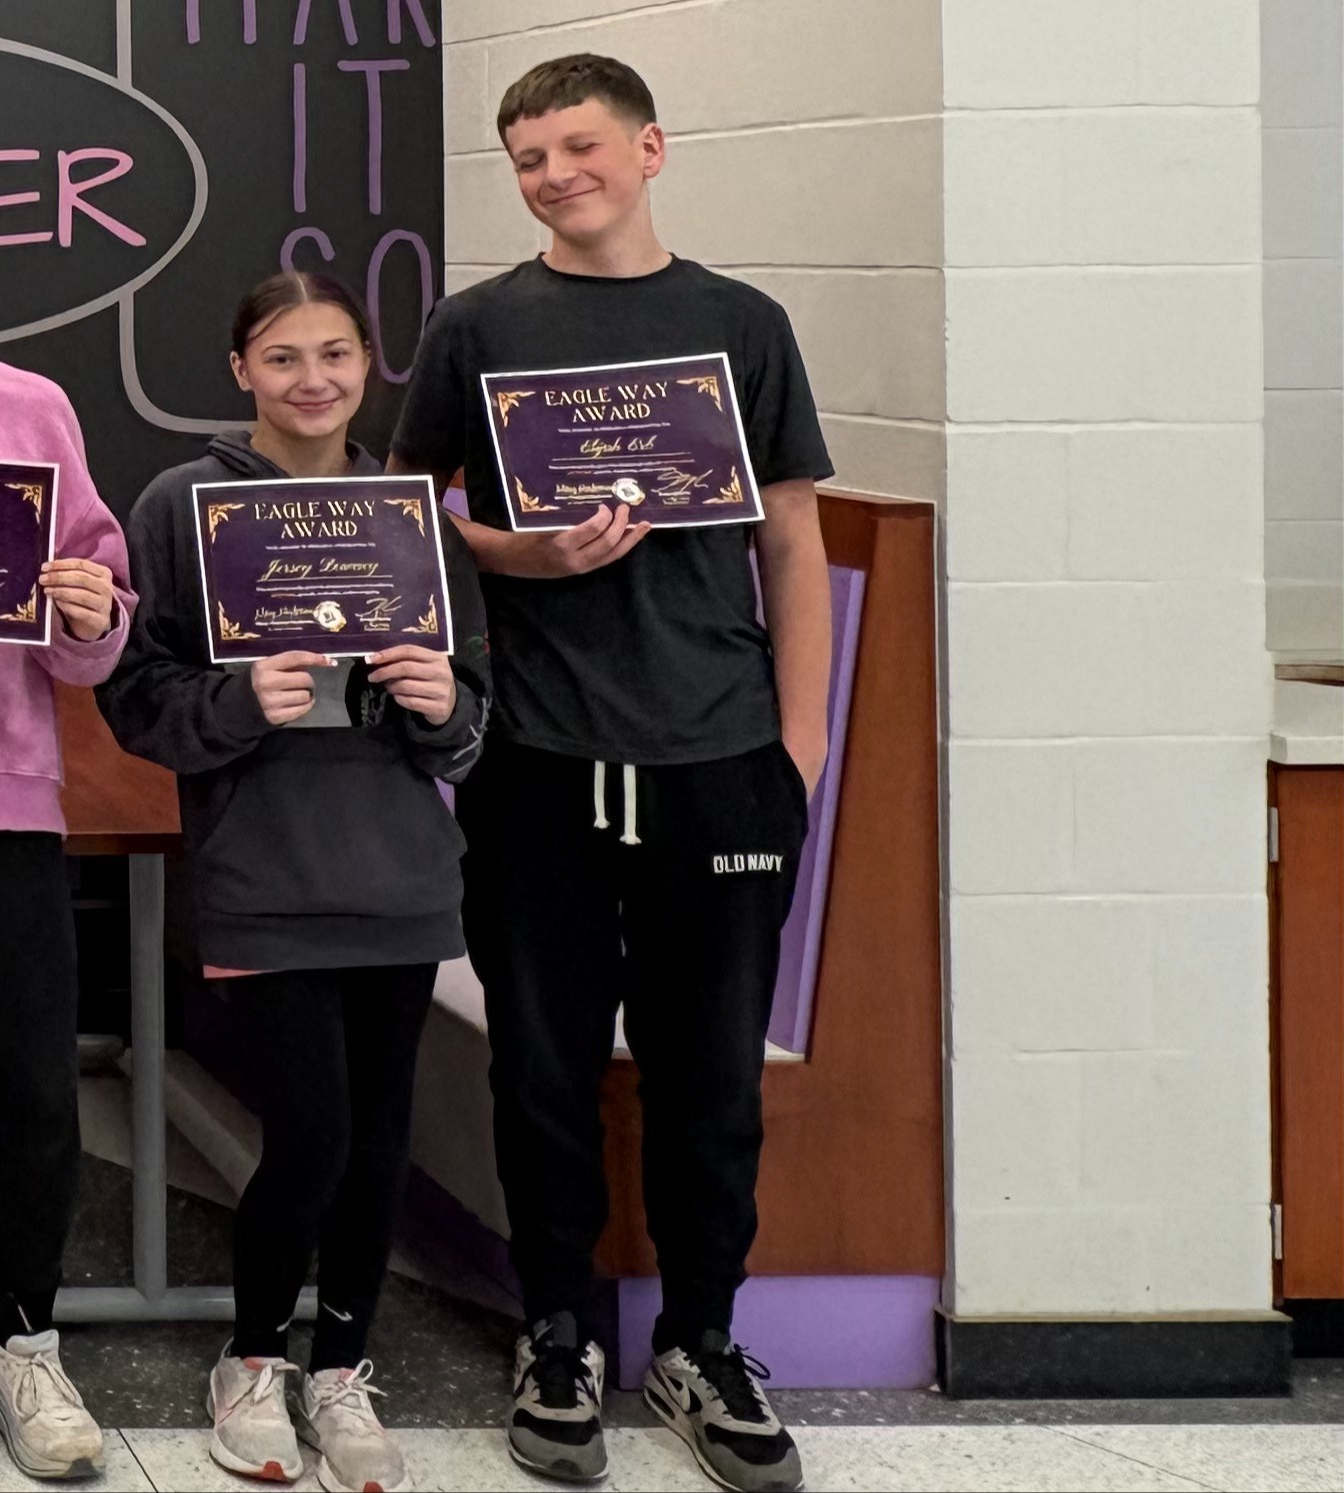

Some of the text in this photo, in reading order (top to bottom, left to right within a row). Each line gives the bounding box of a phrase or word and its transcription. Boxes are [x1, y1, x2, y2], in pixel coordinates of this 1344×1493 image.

[292, 59, 410, 214] IT
[545, 382, 668, 406] EAGLE WAY
[572, 403, 651, 423] AWARD
[254, 500, 375, 520] EAGLE WAY
[281, 521, 358, 539] AWARD
[261, 558, 313, 580] Jersey
[713, 854, 784, 874] OLD NAVY
